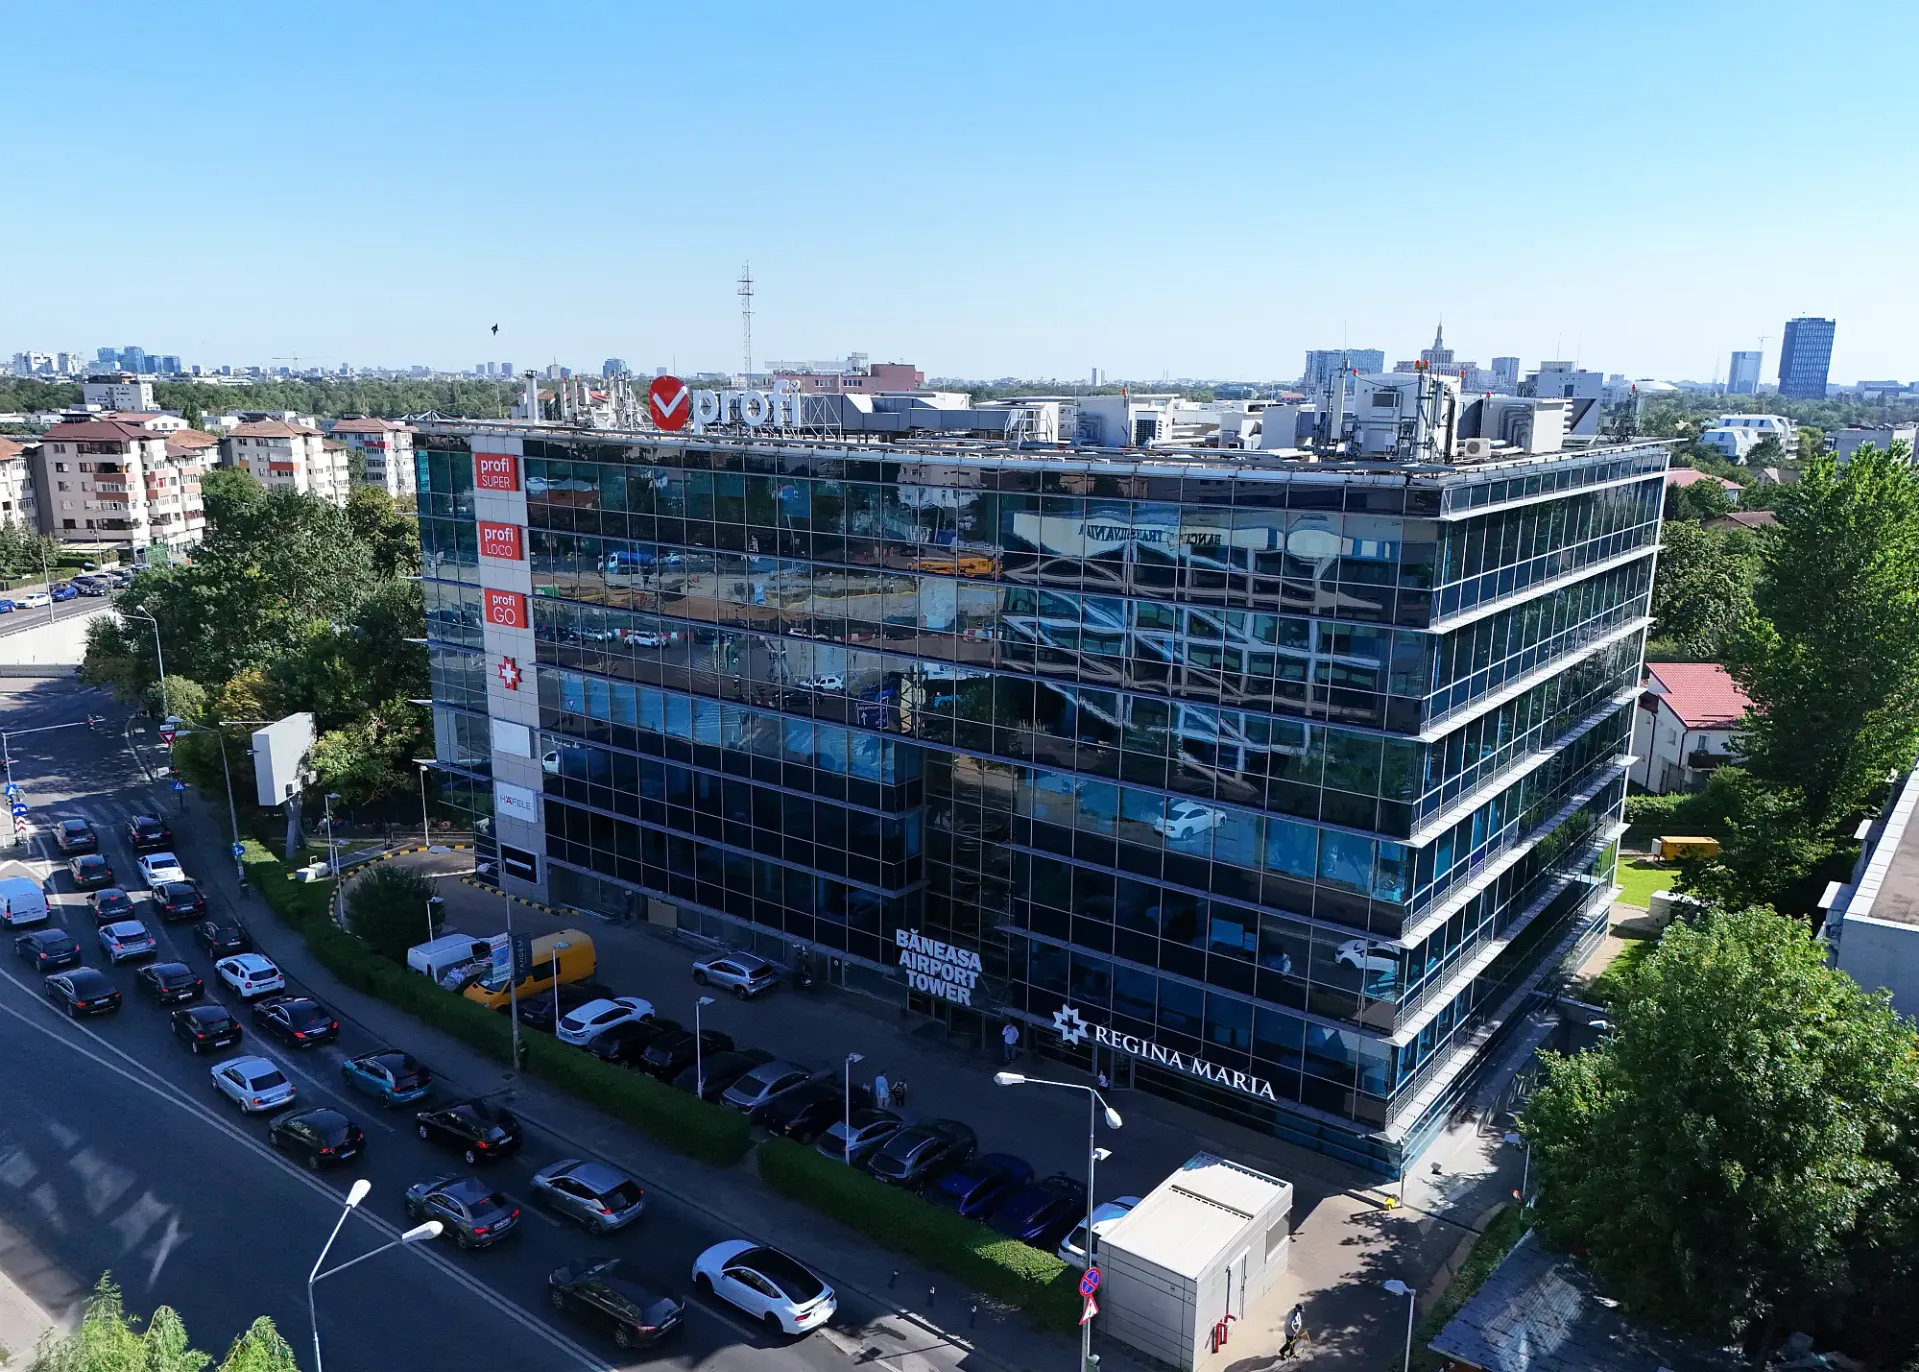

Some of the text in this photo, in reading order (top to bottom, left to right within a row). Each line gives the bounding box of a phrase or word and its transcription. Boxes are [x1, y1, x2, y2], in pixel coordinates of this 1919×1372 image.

[693, 379, 801, 435] profi
[480, 458, 510, 474] profi
[481, 475, 510, 489] SUPER
[484, 528, 514, 542] profi
[486, 542, 513, 557] LOCO
[492, 595, 516, 607] profi
[493, 606, 516, 625] GO
[896, 928, 983, 973] BĂNEASA
[899, 949, 979, 989] AIRPORT
[906, 969, 971, 1007] TOWER
[1095, 1025, 1278, 1102] REGINA MARIA
